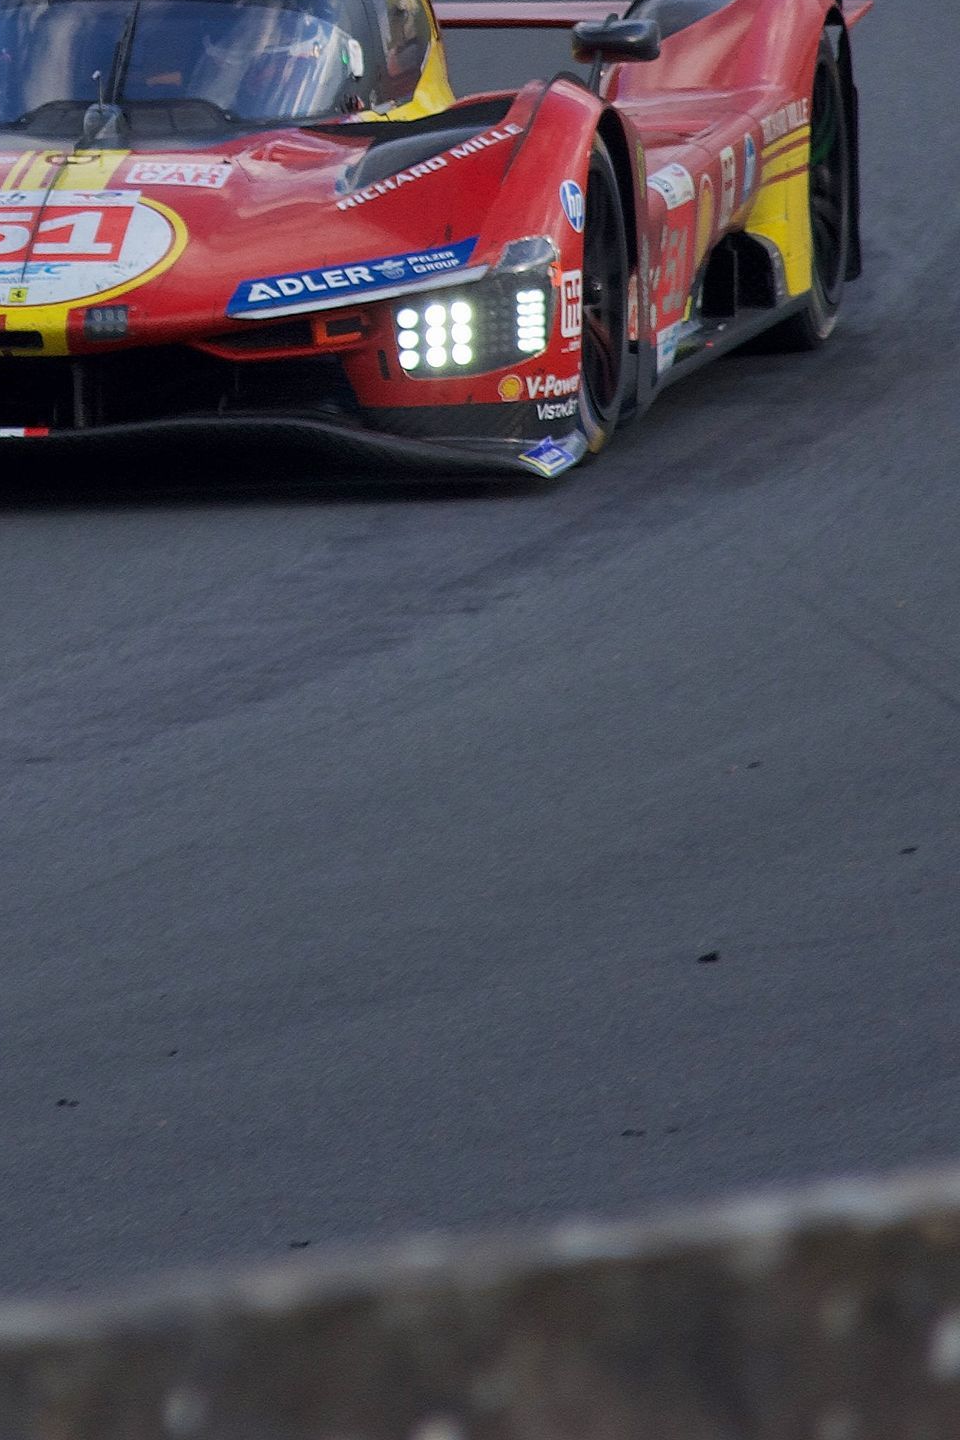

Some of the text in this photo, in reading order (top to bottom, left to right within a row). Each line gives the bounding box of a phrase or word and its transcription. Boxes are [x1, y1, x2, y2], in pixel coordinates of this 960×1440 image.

[336, 123, 524, 210] RICHARD MILLE
[565, 182, 582, 229] hp
[248, 266, 375, 302] ADLER
